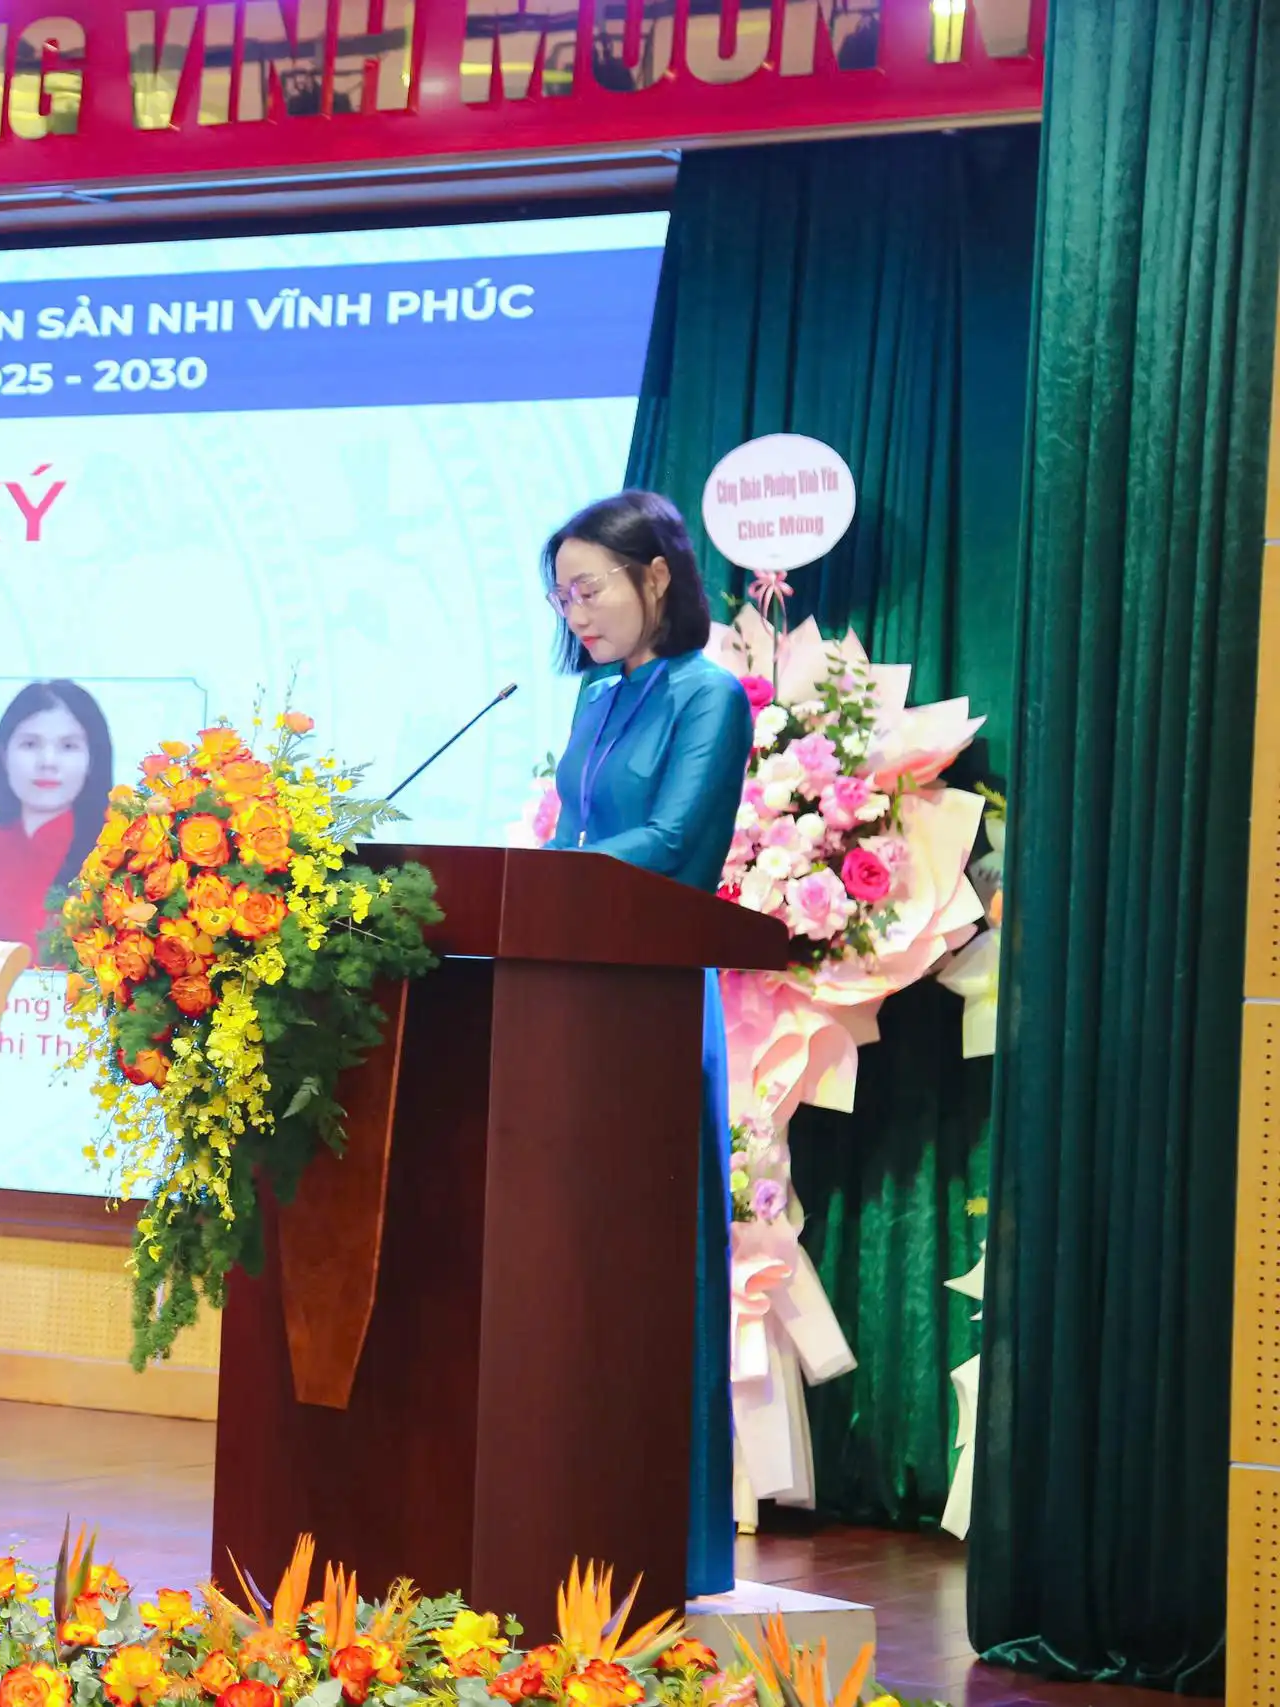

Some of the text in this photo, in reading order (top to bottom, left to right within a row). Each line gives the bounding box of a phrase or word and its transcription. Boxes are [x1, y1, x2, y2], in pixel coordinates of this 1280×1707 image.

[125, 0, 414, 131] VINH
[37, 295, 134, 339] SẢN
[148, 299, 234, 334] NHI
[247, 288, 372, 330] VĨNH
[388, 278, 535, 324] PHÚC
[65, 375, 82, 384] -
[93, 356, 208, 392] 2030
